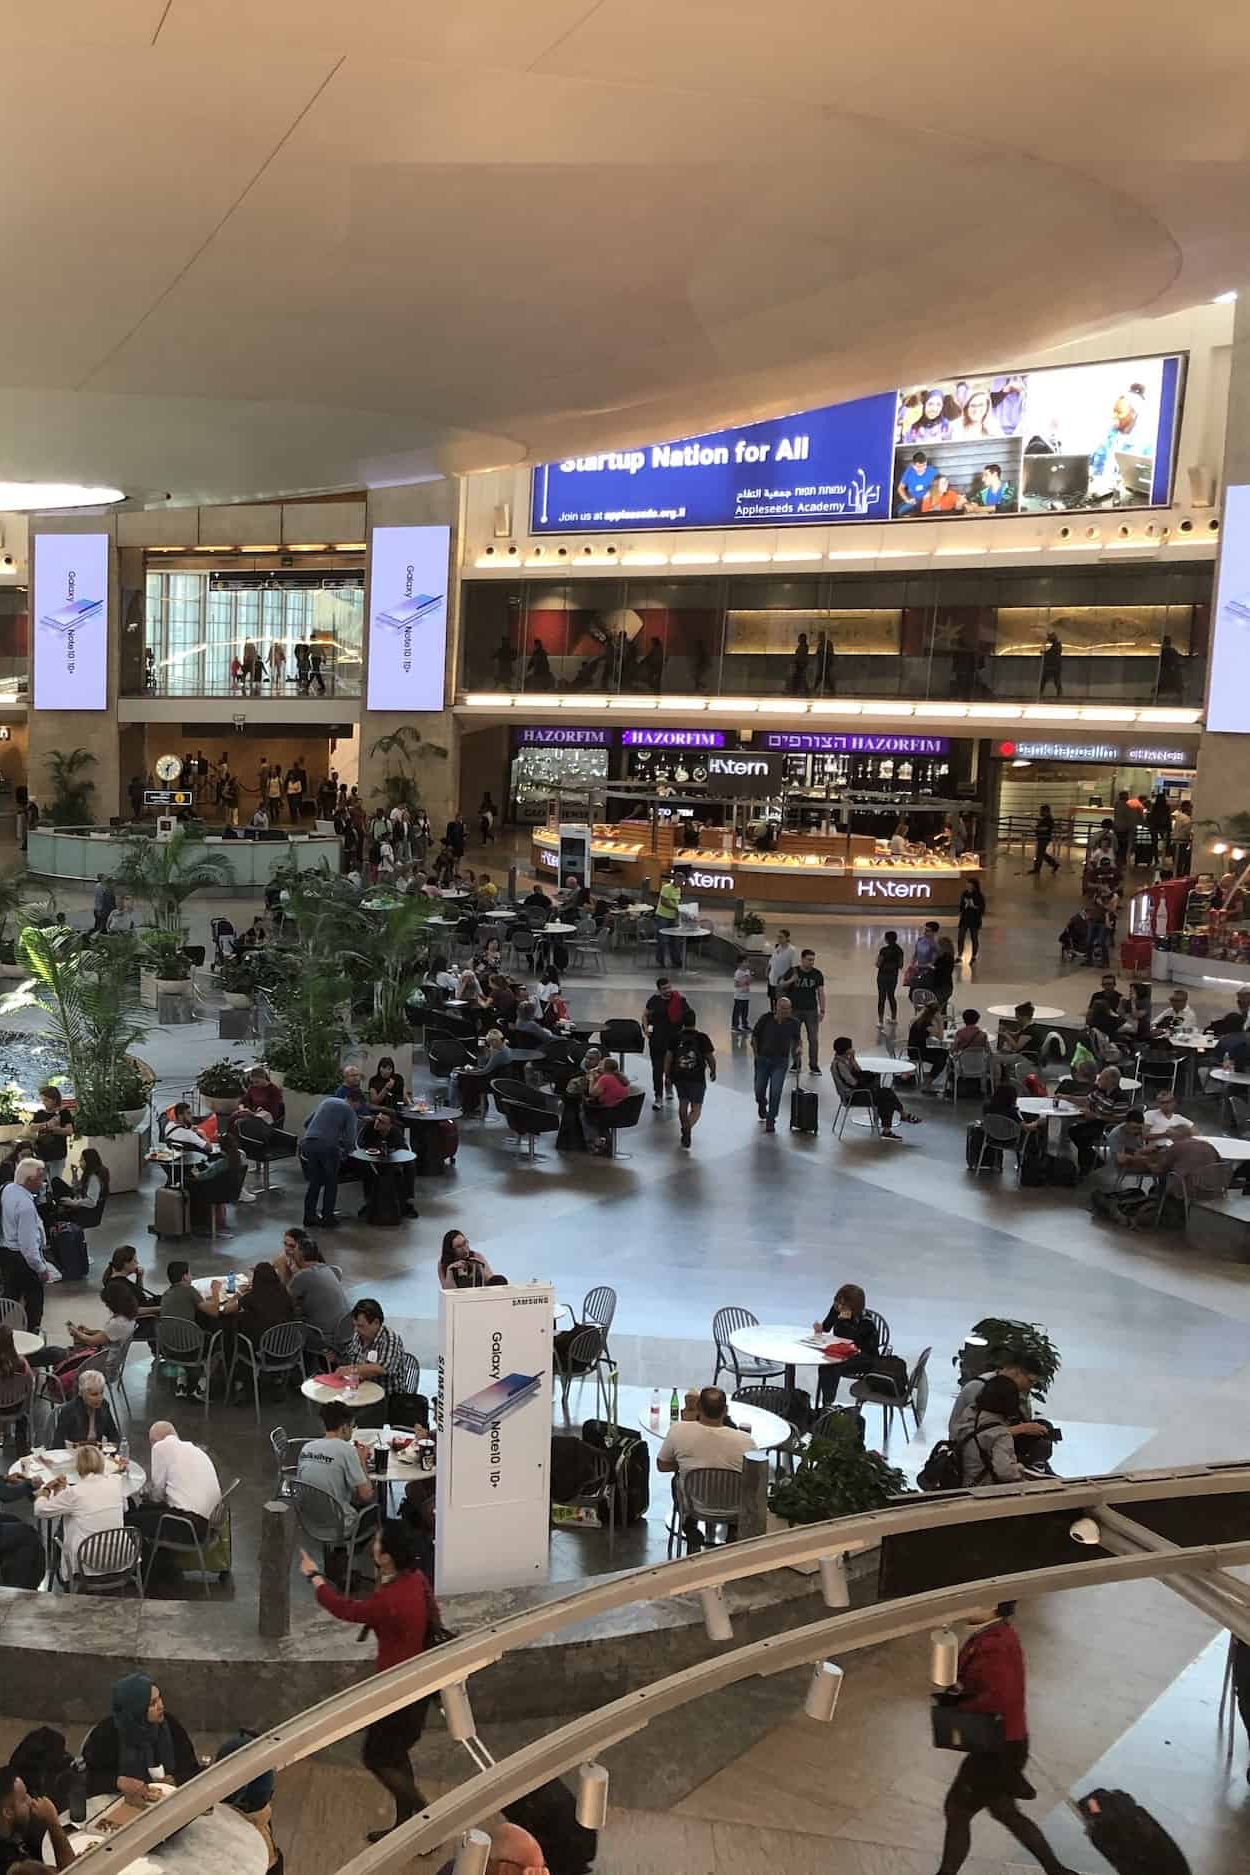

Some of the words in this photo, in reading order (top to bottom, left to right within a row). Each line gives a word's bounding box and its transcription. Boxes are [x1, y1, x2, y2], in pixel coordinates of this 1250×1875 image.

[652, 444, 727, 468] Nation
[735, 440, 770, 463] for
[776, 436, 809, 460] All
[558, 511, 579, 522] Join
[580, 511, 592, 521] us
[593, 511, 603, 520] at
[735, 503, 794, 517] Appleseeds
[797, 501, 846, 513] Academy
[66, 571, 76, 601] Galaxy
[404, 565, 414, 598] Galaxy
[523, 729, 605, 743] HAZORFIM
[631, 730, 715, 746] HAZORFIM
[768, 735, 847, 749] הצורפים
[852, 738, 941, 752] HAZORFIM
[512, 1296, 549, 1306] SAMSUNG
[489, 1331, 502, 1380] Galaxy
[437, 1355, 446, 1433] SAMSUNG
[490, 1421, 501, 1464] Note10
